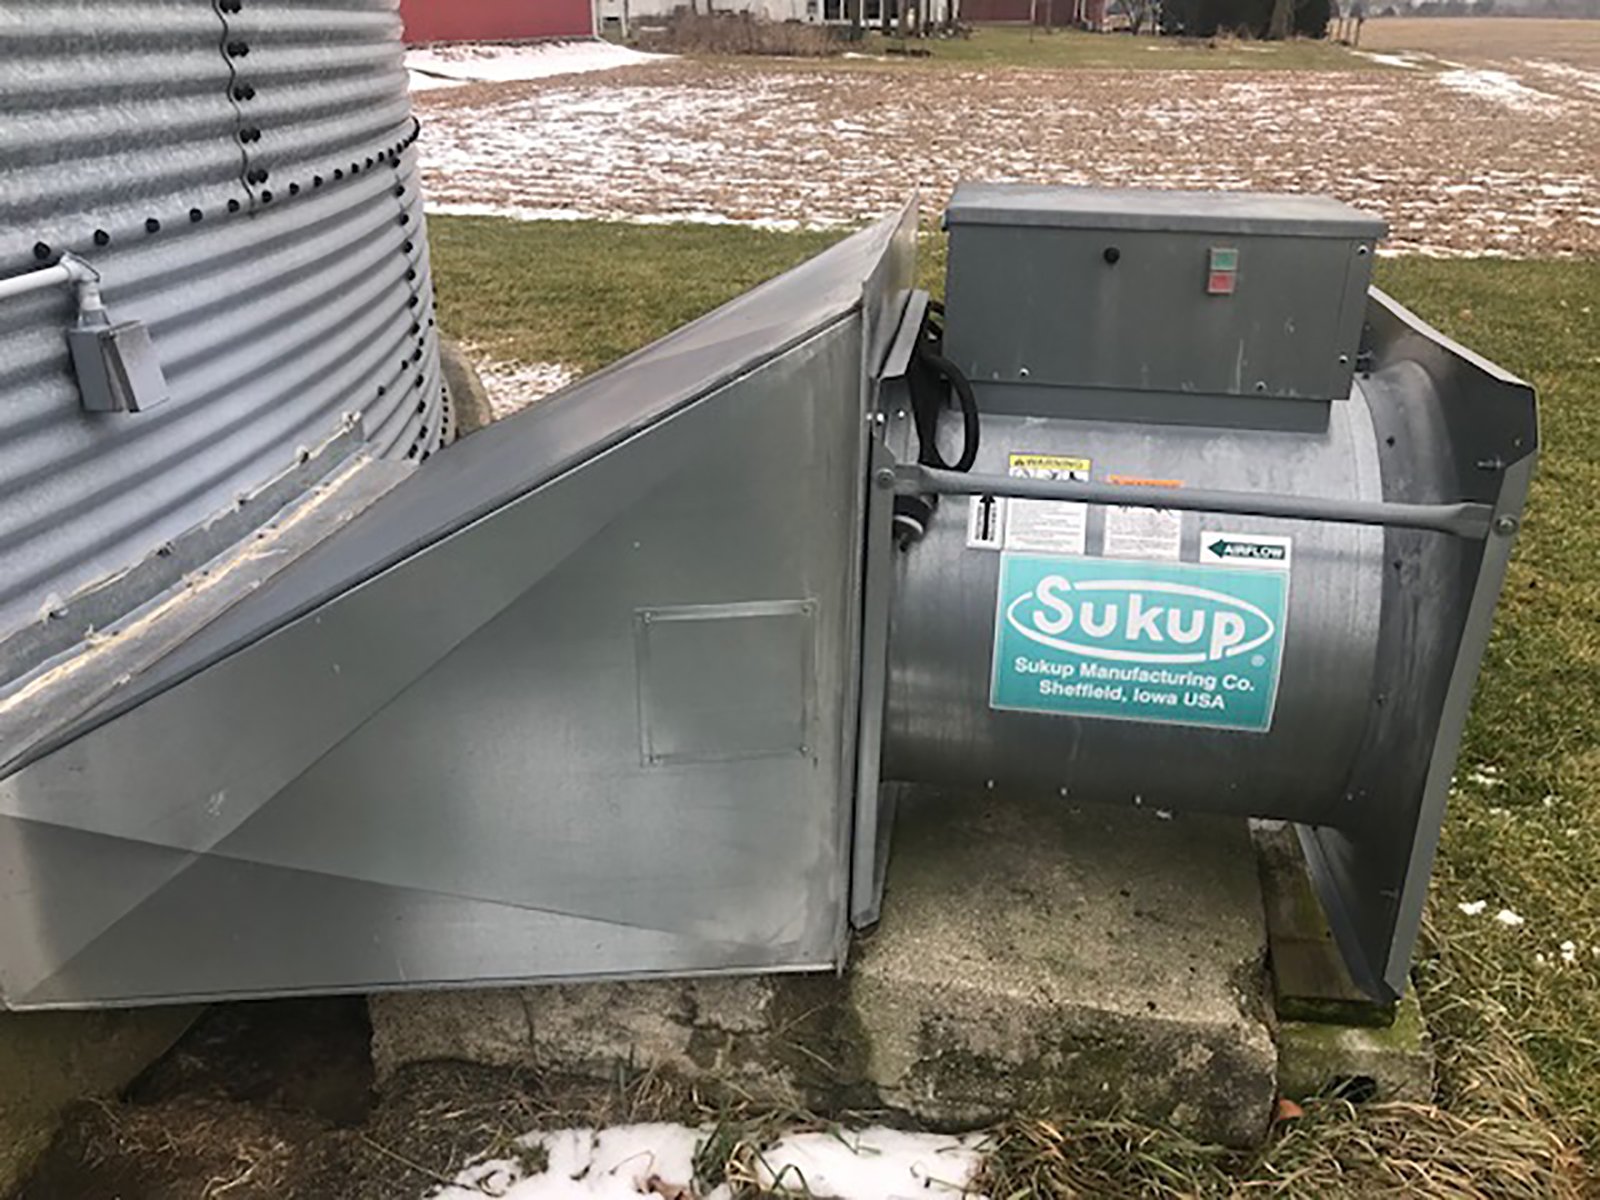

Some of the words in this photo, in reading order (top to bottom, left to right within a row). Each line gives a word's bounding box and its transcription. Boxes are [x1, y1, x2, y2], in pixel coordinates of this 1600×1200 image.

[1224, 544, 1284, 560] AIRFLOW
[1033, 575, 1246, 661] Sukup
[1014, 656, 1074, 680] Sukup
[1080, 661, 1217, 691] Manufacturing
[1222, 674, 1254, 692] Co.
[1039, 680, 1128, 703] Sheffield,
[1133, 687, 1178, 706] Iowa
[1183, 693, 1225, 710] USA
